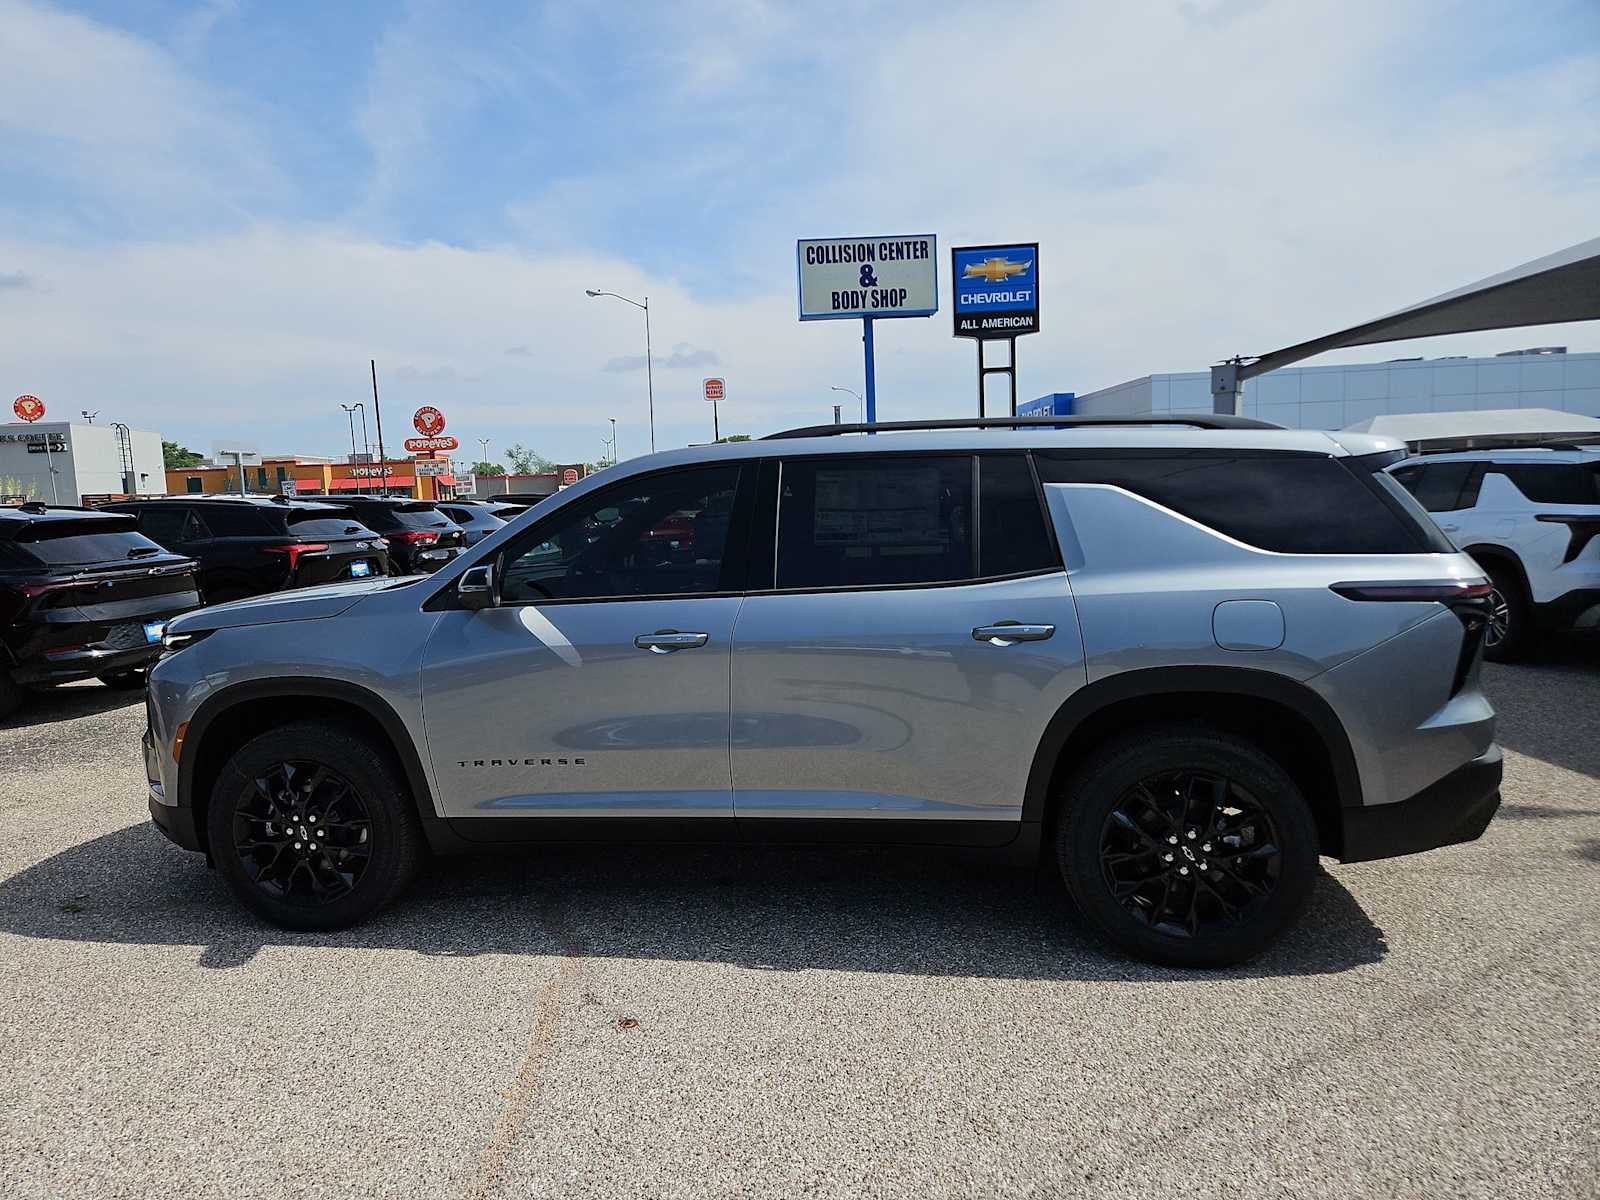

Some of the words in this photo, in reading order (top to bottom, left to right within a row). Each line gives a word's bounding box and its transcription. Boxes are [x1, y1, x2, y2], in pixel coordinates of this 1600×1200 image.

[806, 243, 876, 265] COLLISION
[879, 240, 929, 261] CENTER
[859, 264, 878, 288] &
[831, 290, 868, 310] BODY
[871, 288, 907, 308] SHOP
[960, 290, 1032, 305] CHEVROLET
[960, 319, 979, 330] ALL
[981, 316, 1033, 329] AMERICAN
[408, 438, 453, 449] POPEYES
[456, 758, 585, 767] TRAVERSE
